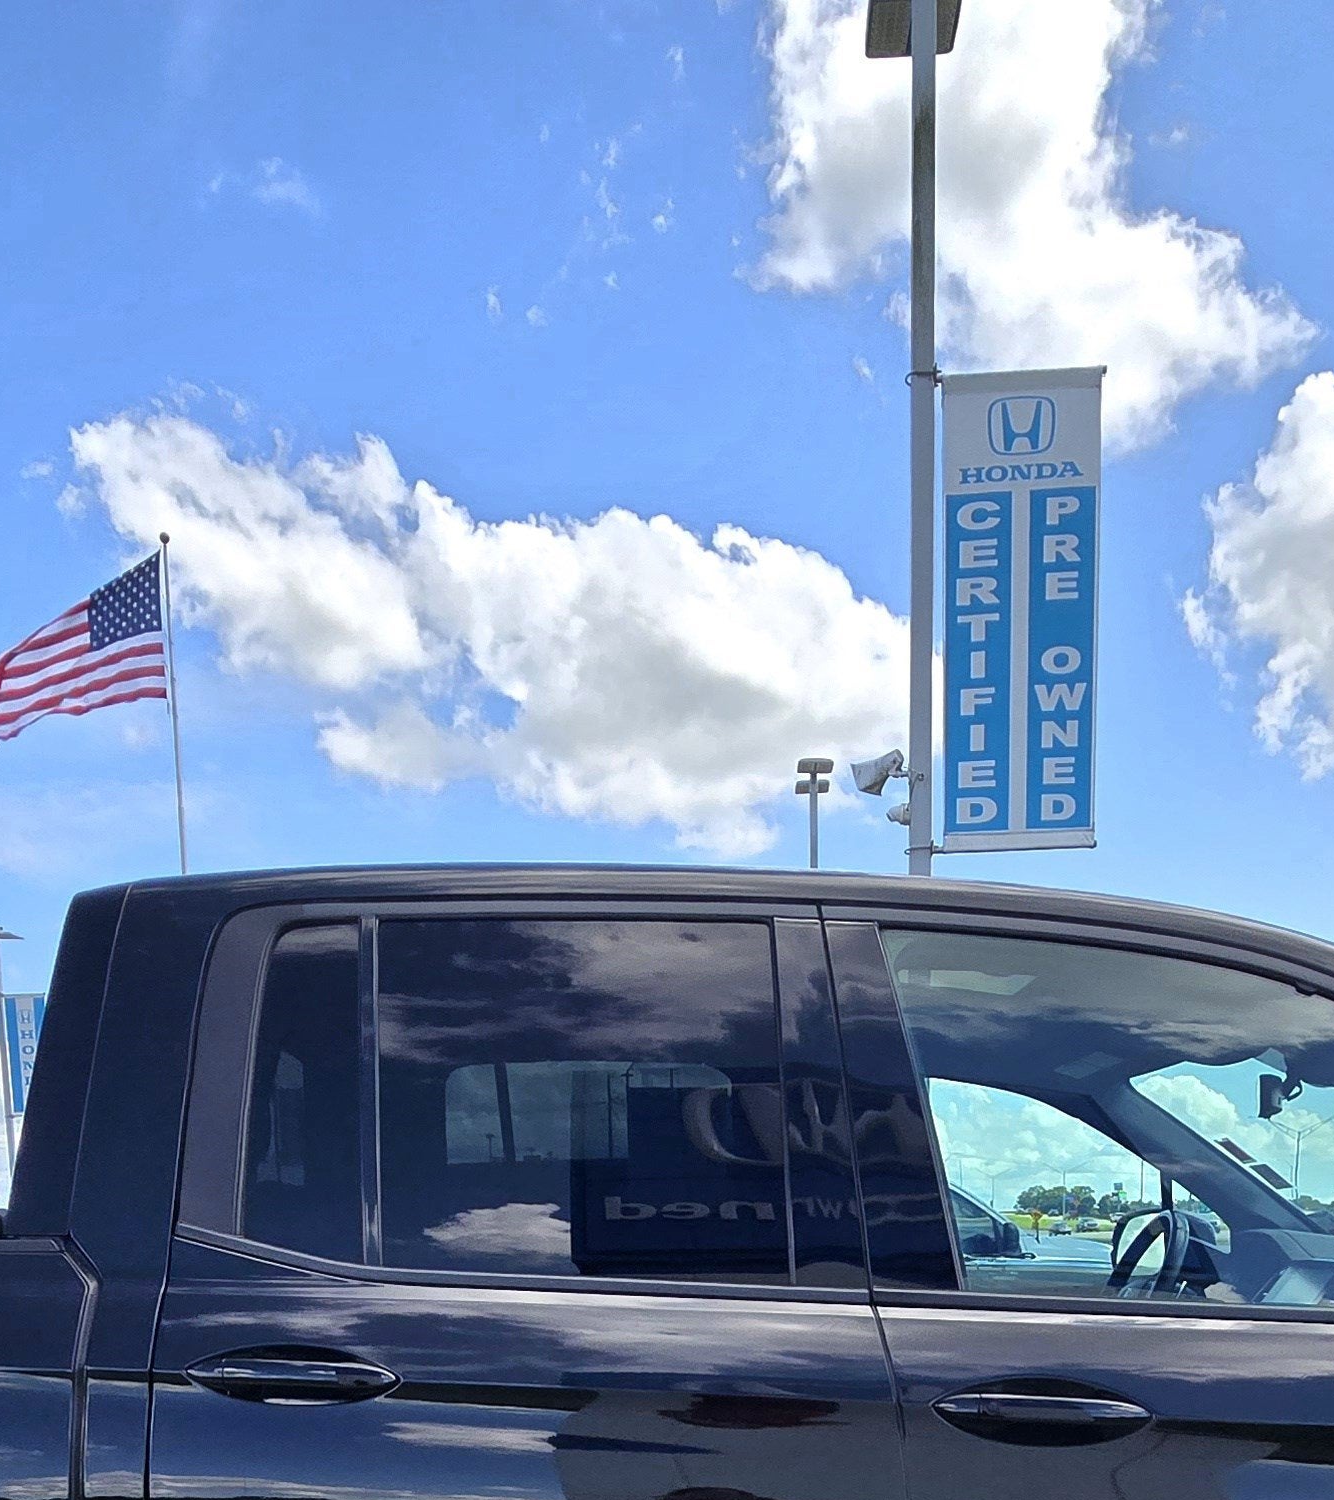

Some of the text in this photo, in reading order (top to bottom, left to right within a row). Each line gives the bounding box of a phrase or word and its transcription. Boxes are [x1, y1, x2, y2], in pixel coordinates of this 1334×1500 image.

[958, 461, 1083, 485] HONDA
[955, 500, 1002, 825] CERTIFIED
[1033, 495, 1088, 822] PRE OWNED
[20, 1029, 35, 1086] HON
